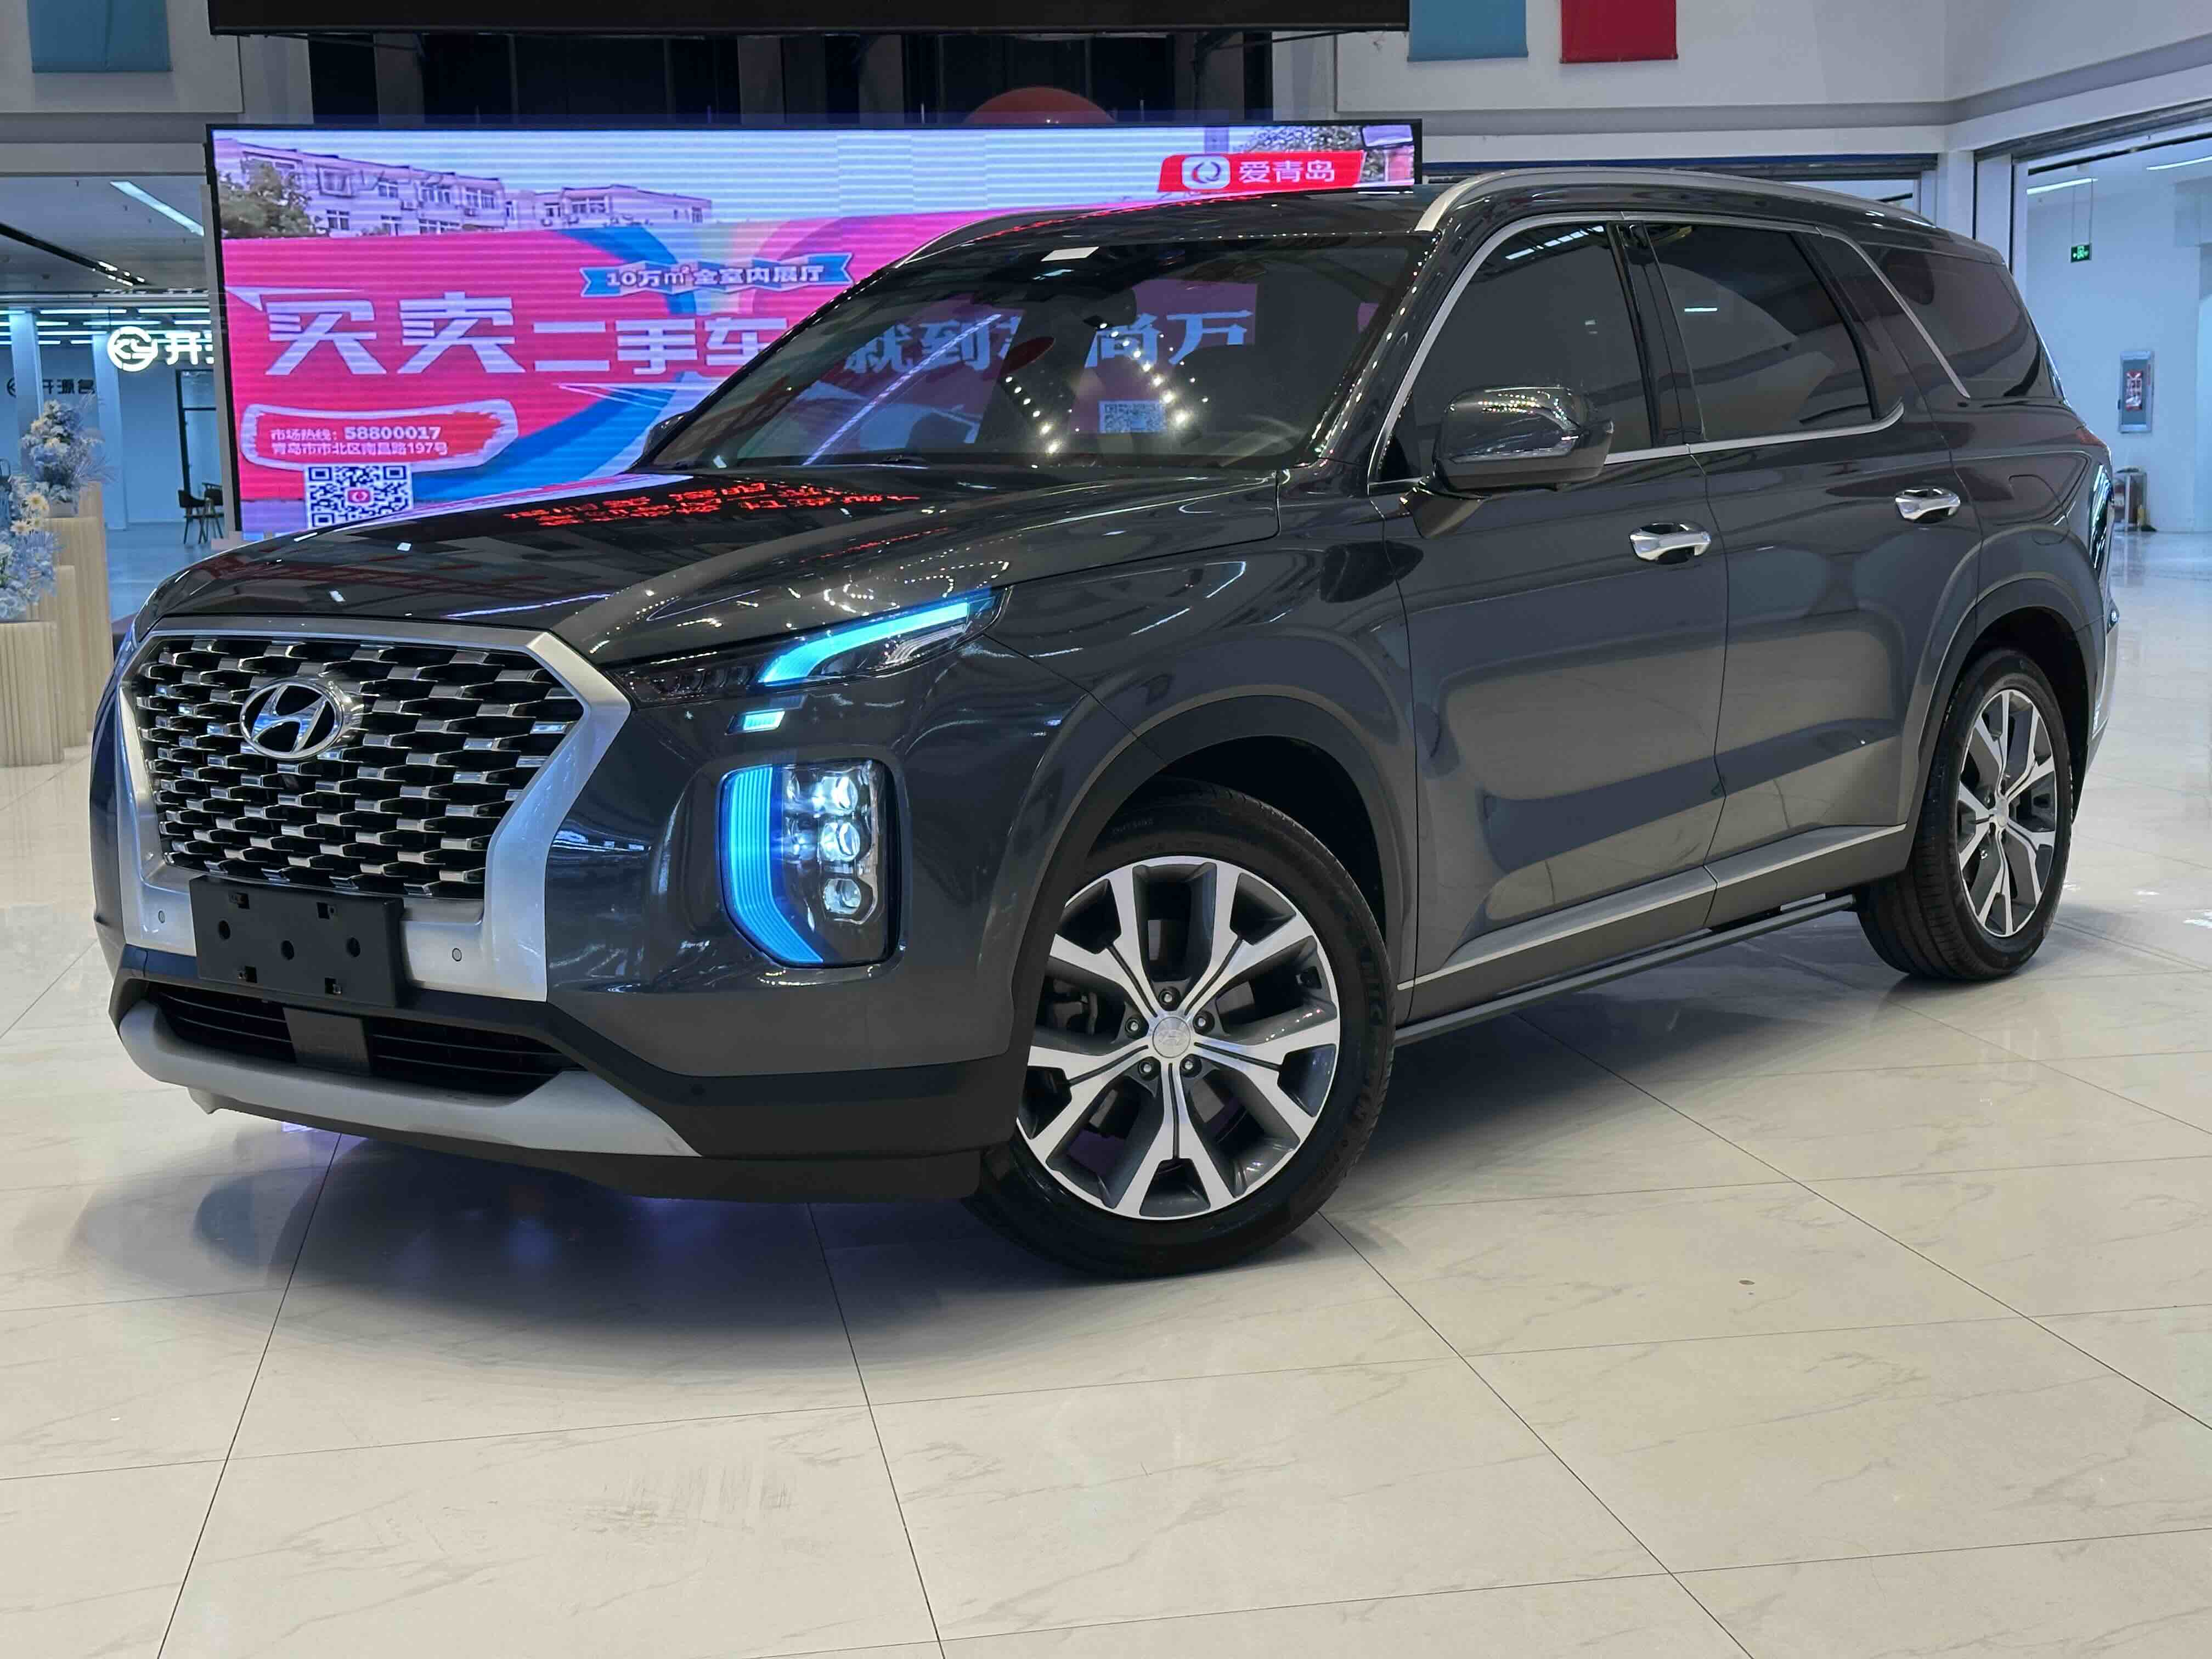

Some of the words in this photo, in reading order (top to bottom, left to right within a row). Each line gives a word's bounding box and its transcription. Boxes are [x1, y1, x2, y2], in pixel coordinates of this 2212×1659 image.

[1239, 160, 1335, 183] 爱青岛
[265, 291, 788, 376] 买卖二手车
[344, 426, 441, 440] 58800017
